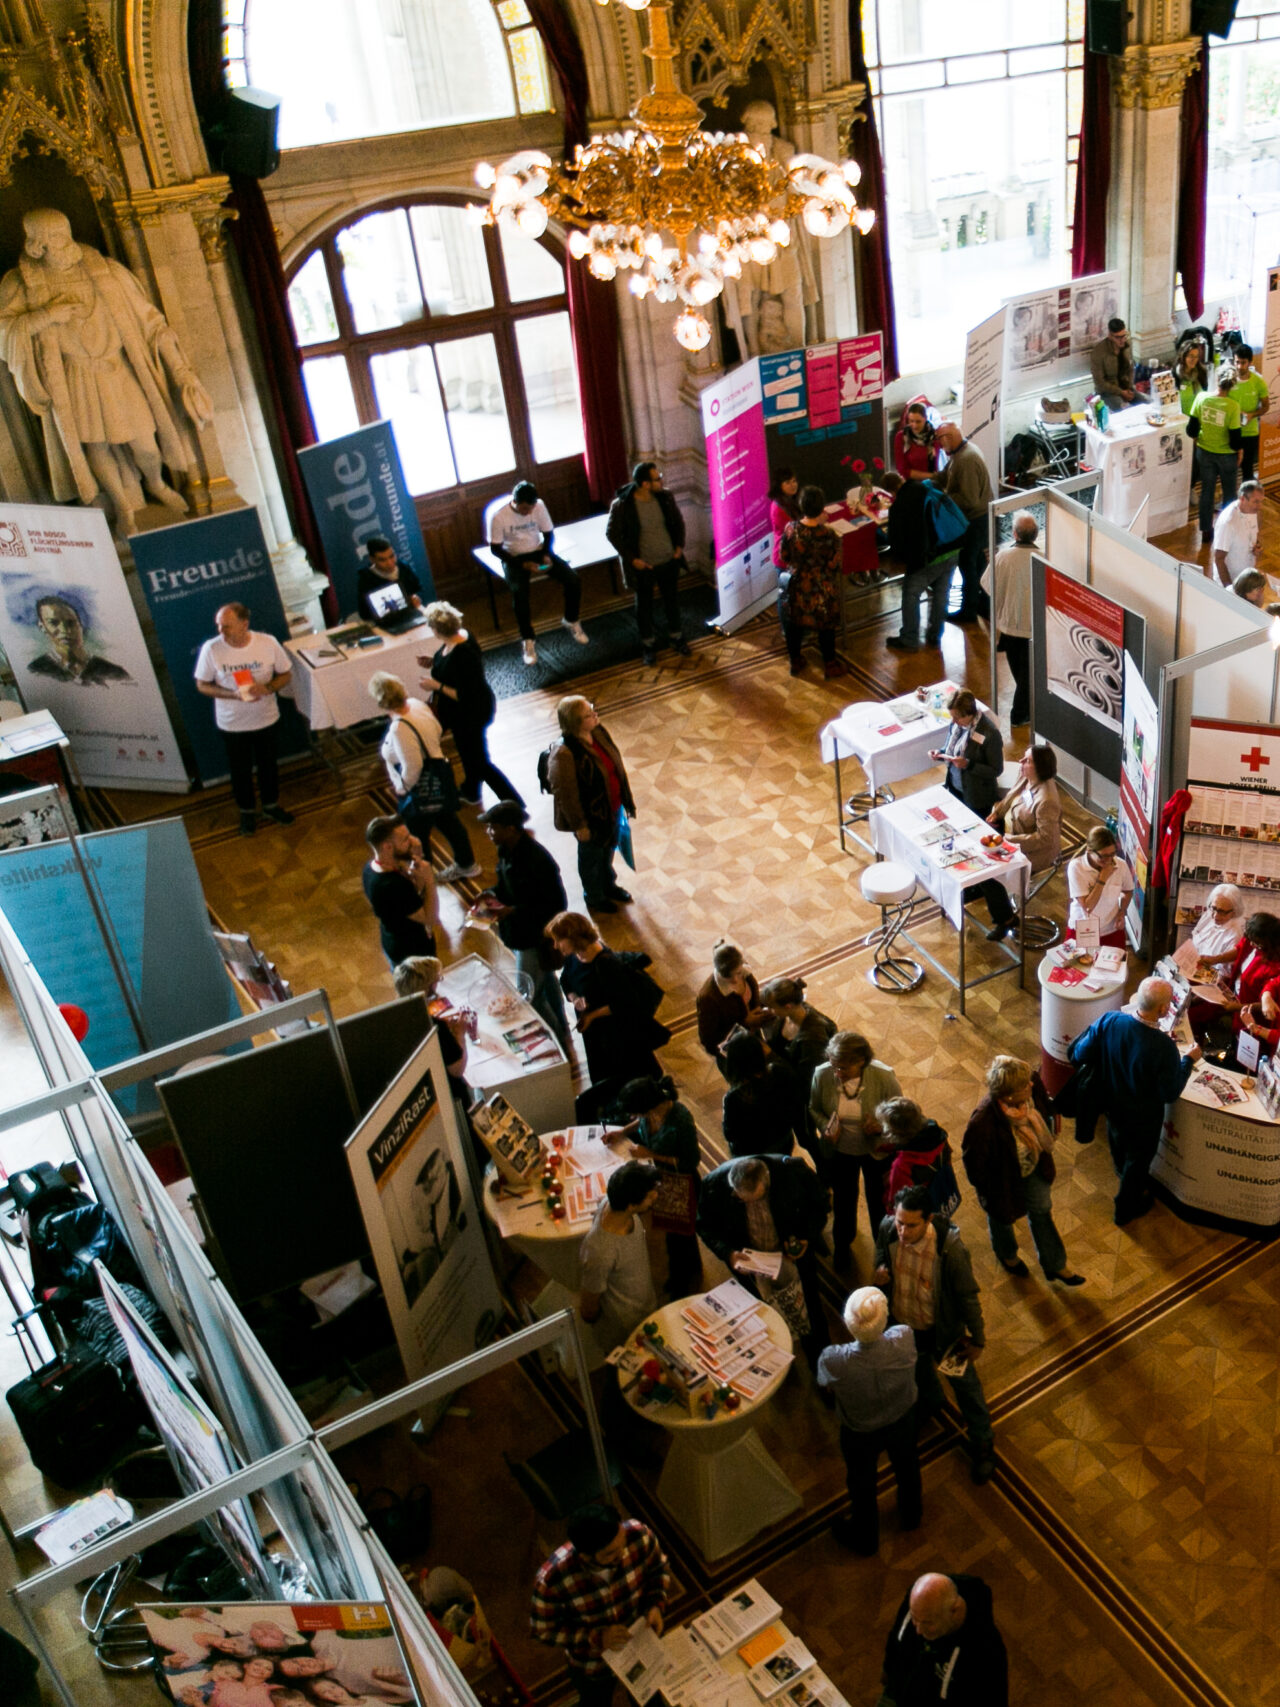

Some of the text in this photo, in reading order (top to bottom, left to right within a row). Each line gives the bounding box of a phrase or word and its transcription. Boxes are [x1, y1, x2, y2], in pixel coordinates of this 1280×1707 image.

[147, 547, 264, 593] Freunde
[1240, 776, 1268, 784] WIENER
[374, 1085, 431, 1164] VinziRast
